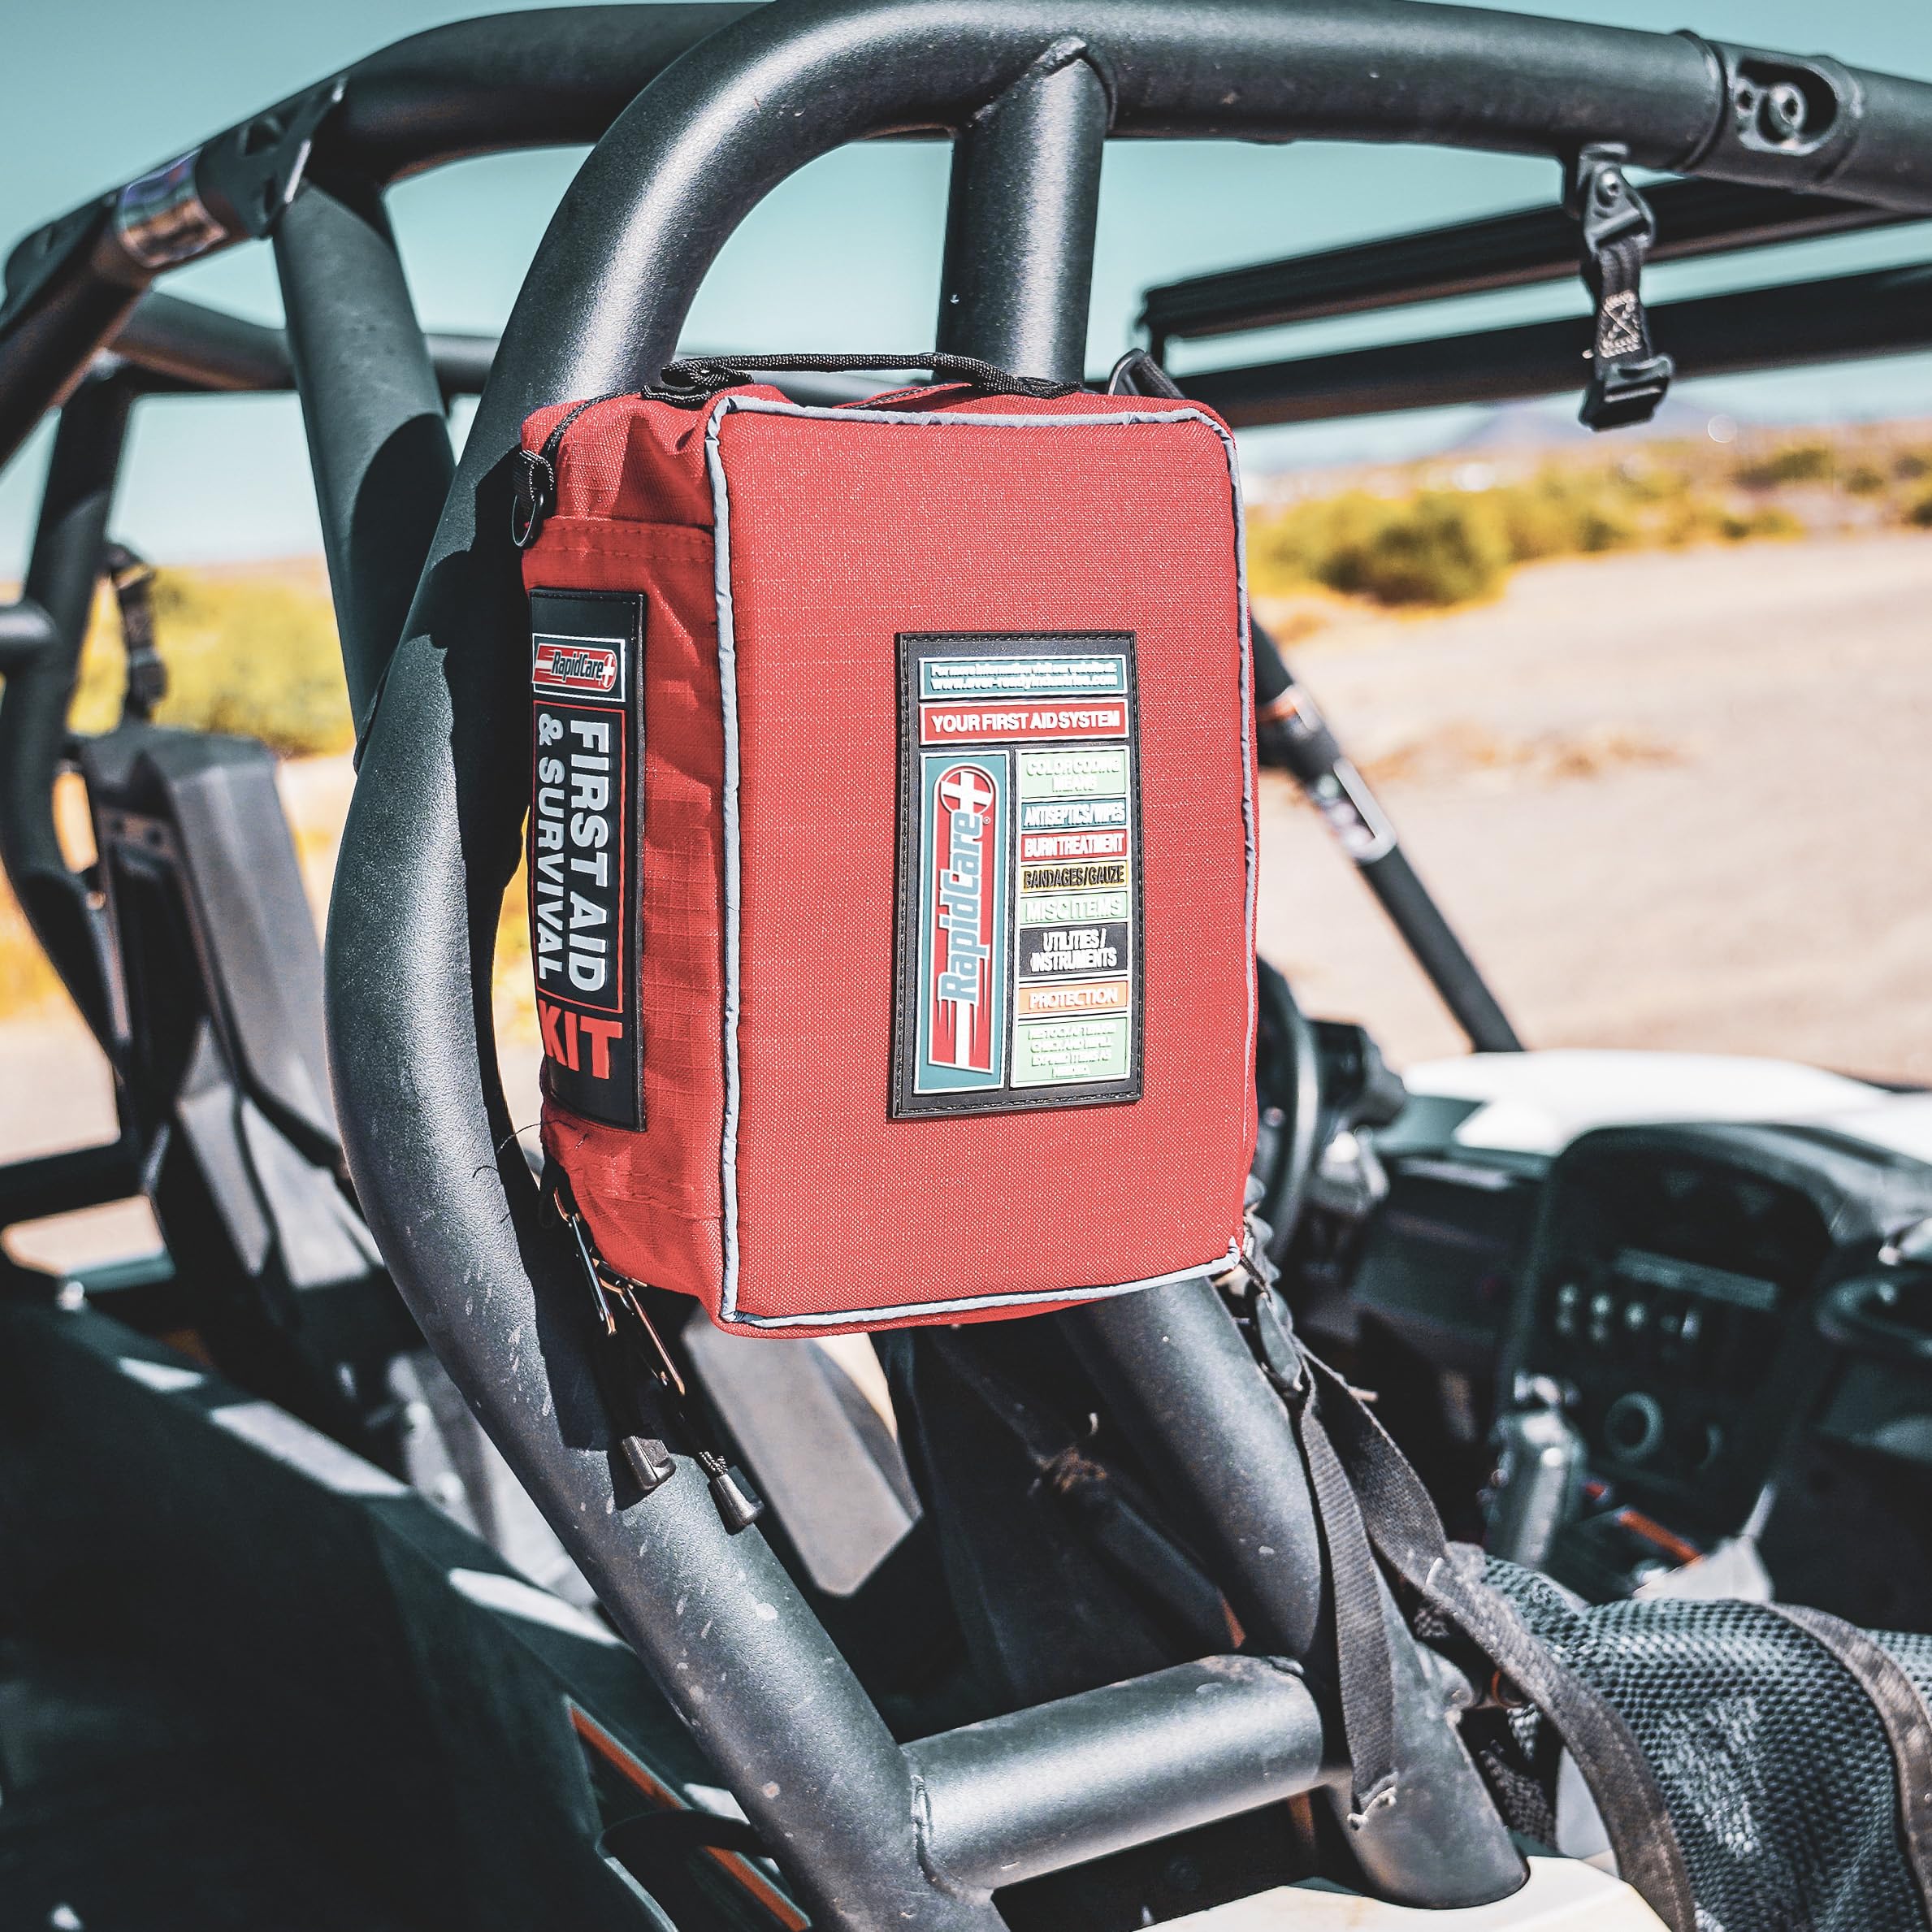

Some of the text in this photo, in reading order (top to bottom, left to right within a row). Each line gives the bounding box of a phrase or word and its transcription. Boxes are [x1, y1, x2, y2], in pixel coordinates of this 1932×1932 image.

[551, 651, 604, 682] RapidCare
[931, 710, 1120, 733] YOUR FIRST AID SYSTEM
[537, 713, 565, 980] & SURVIVAL
[569, 720, 609, 992] FIRST AID
[1024, 833, 1125, 858] BURN TREATMENT
[1023, 865, 1125, 889] BANDAGES/GAUZE
[938, 811, 989, 1006] RapidCare
[1025, 896, 1123, 922] MISC ITEMS
[1029, 947, 1118, 972] INSTRUMENTS
[1029, 987, 1119, 1009] PROTECTION
[538, 998, 623, 1080] KIT
